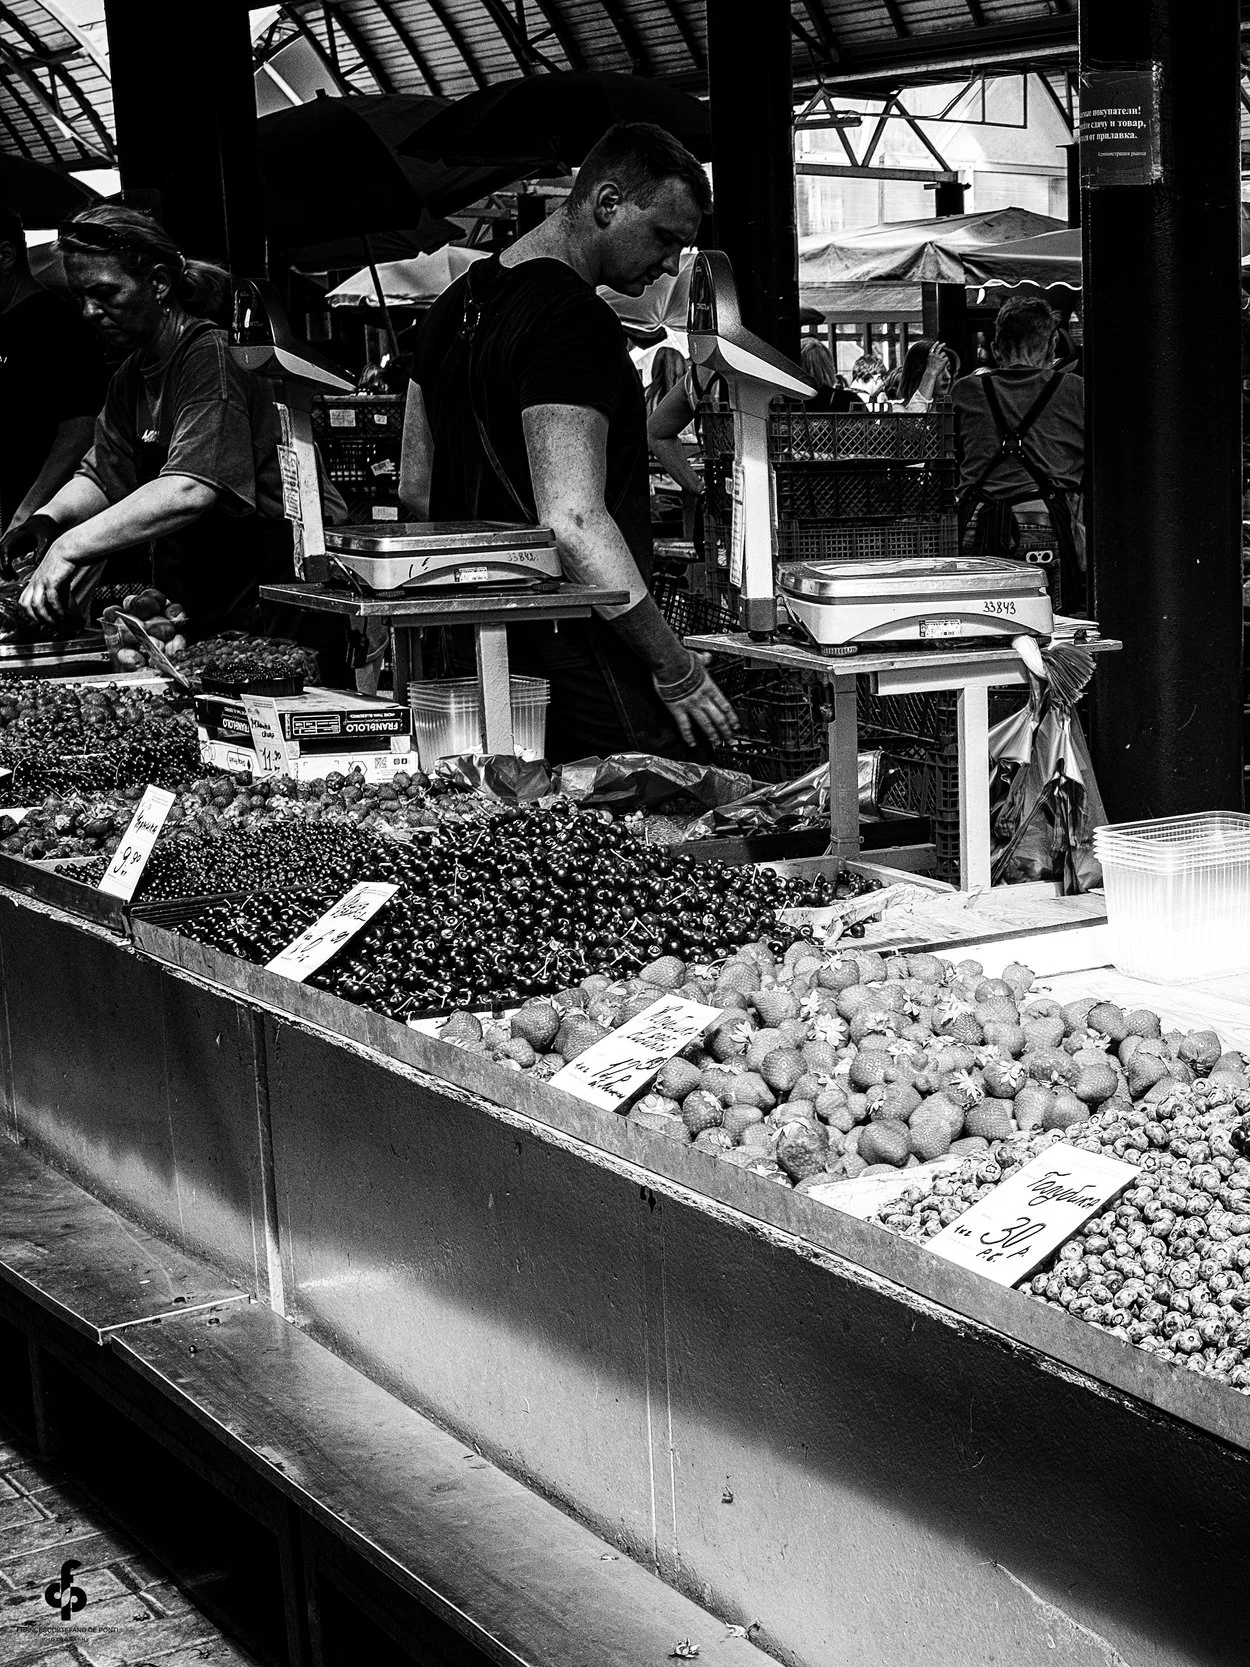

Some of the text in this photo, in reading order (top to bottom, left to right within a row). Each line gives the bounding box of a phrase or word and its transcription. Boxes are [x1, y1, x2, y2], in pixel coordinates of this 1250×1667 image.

[1118, 120, 1146, 129] товар,
[1096, 132, 1138, 142] прилавка.
[982, 600, 1017, 615] 33843
[345, 721, 399, 733] FRAN&LOLO
[1026, 1171, 1101, 1207] Голубика
[979, 1216, 1047, 1249] 30
